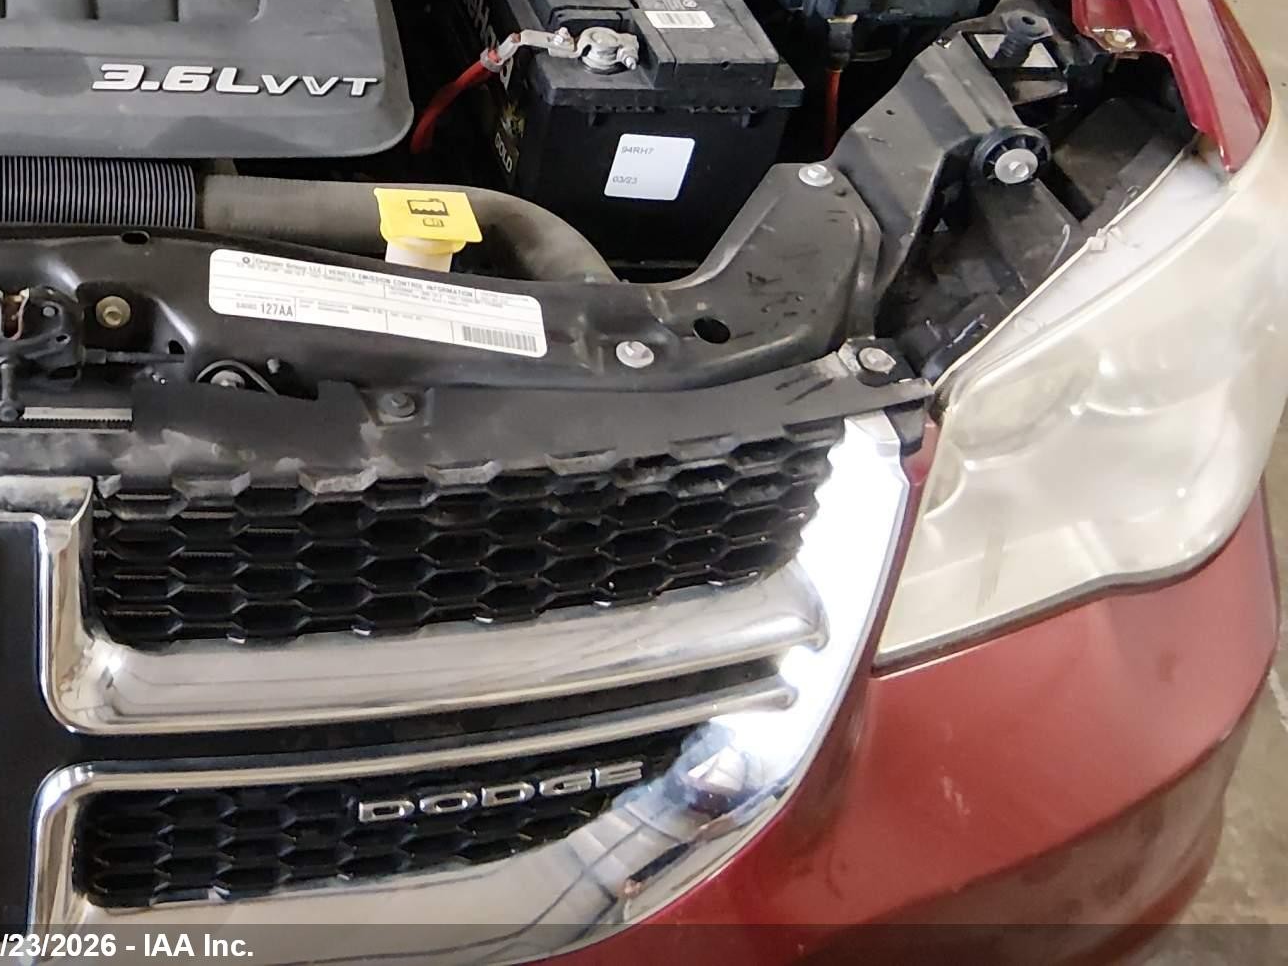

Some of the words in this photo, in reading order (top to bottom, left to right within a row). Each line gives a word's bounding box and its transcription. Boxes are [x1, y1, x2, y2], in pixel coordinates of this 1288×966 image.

[91, 63, 260, 94] 3.6L
[261, 74, 379, 97] VVT
[260, 300, 294, 317] 127AA
[358, 760, 644, 823] DODGE
